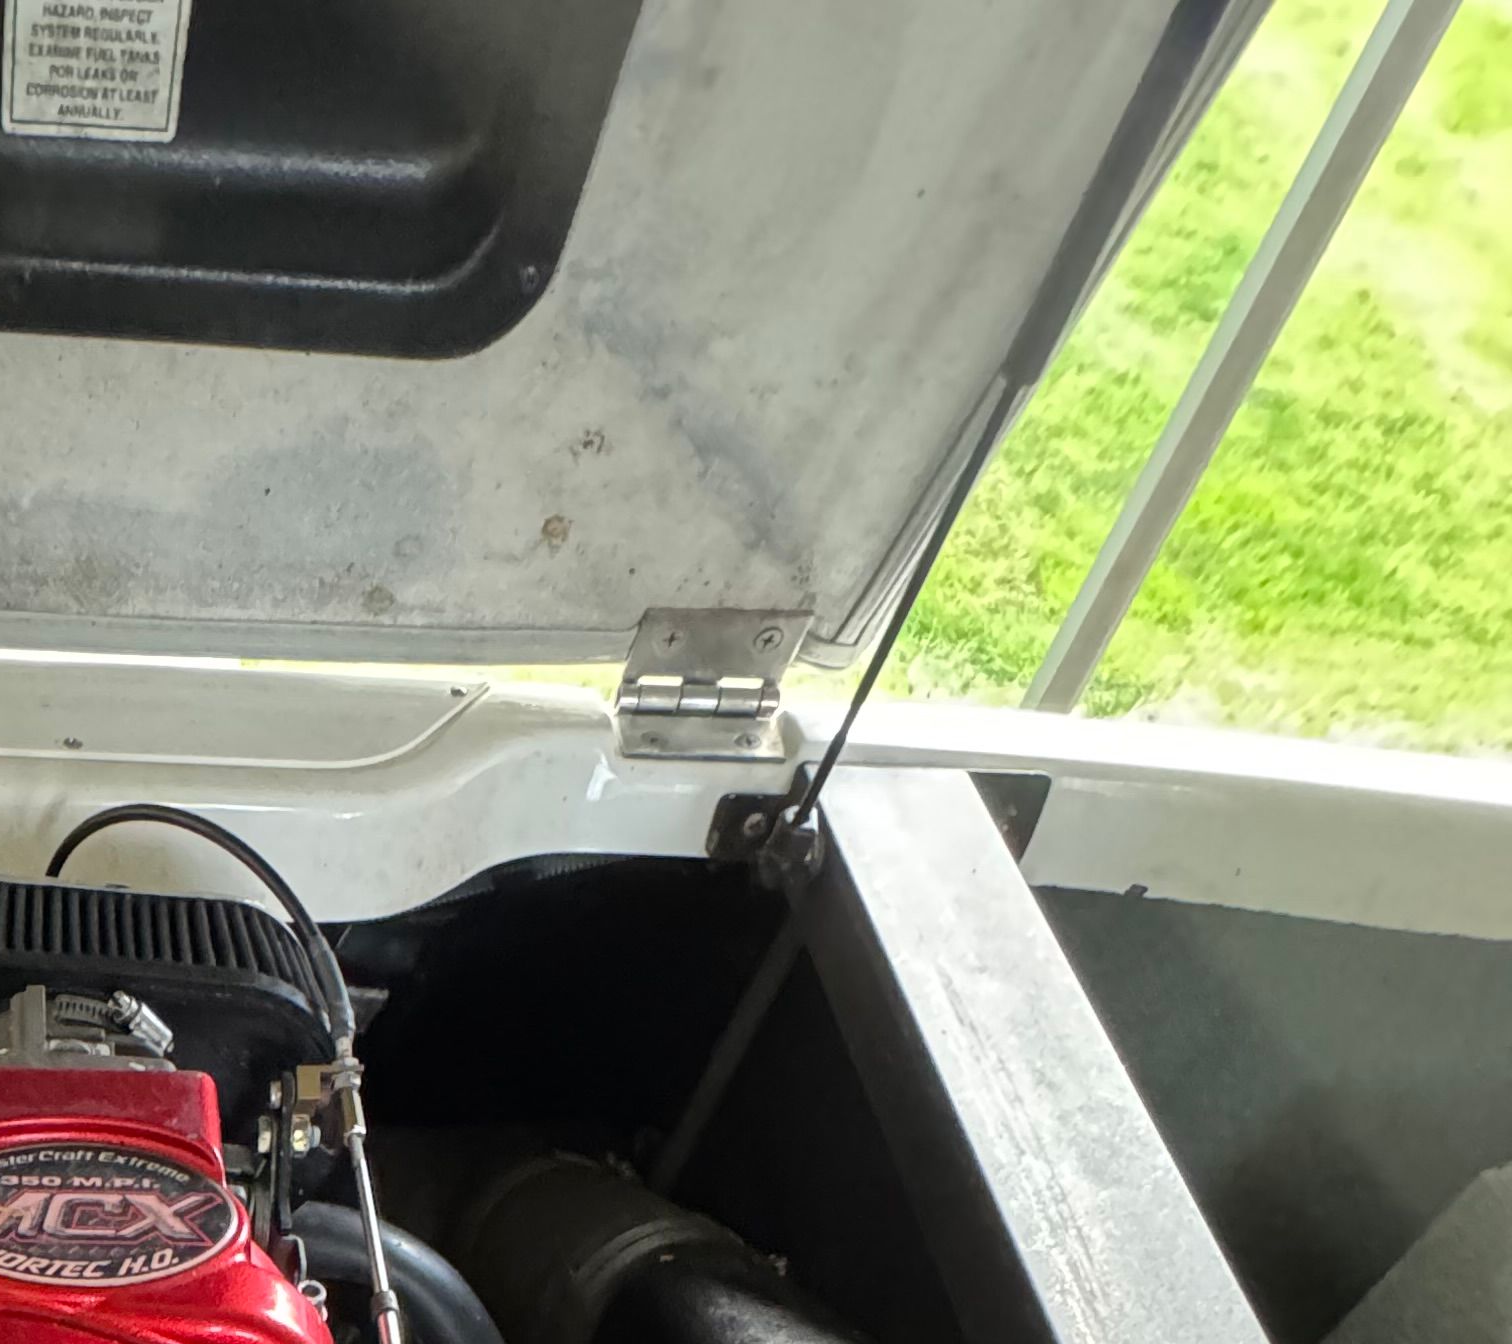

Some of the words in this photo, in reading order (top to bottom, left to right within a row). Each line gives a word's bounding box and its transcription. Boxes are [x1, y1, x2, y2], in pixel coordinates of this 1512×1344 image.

[100, 7, 153, 25] INSPECT
[31, 23, 81, 39] SYSTEM
[28, 42, 82, 60] EXAMINE
[86, 48, 116, 63] FUEL
[120, 49, 160, 65] TANKS
[76, 66, 116, 82] LEAKS
[119, 68, 138, 84] OR
[26, 82, 99, 100] CORROSION
[101, 87, 117, 100] AT
[119, 89, 159, 104] LEAST
[97, 1151, 191, 1182] Extreme
[0, 1174, 62, 1187] 350
[117, 1247, 180, 1276] H.O.
